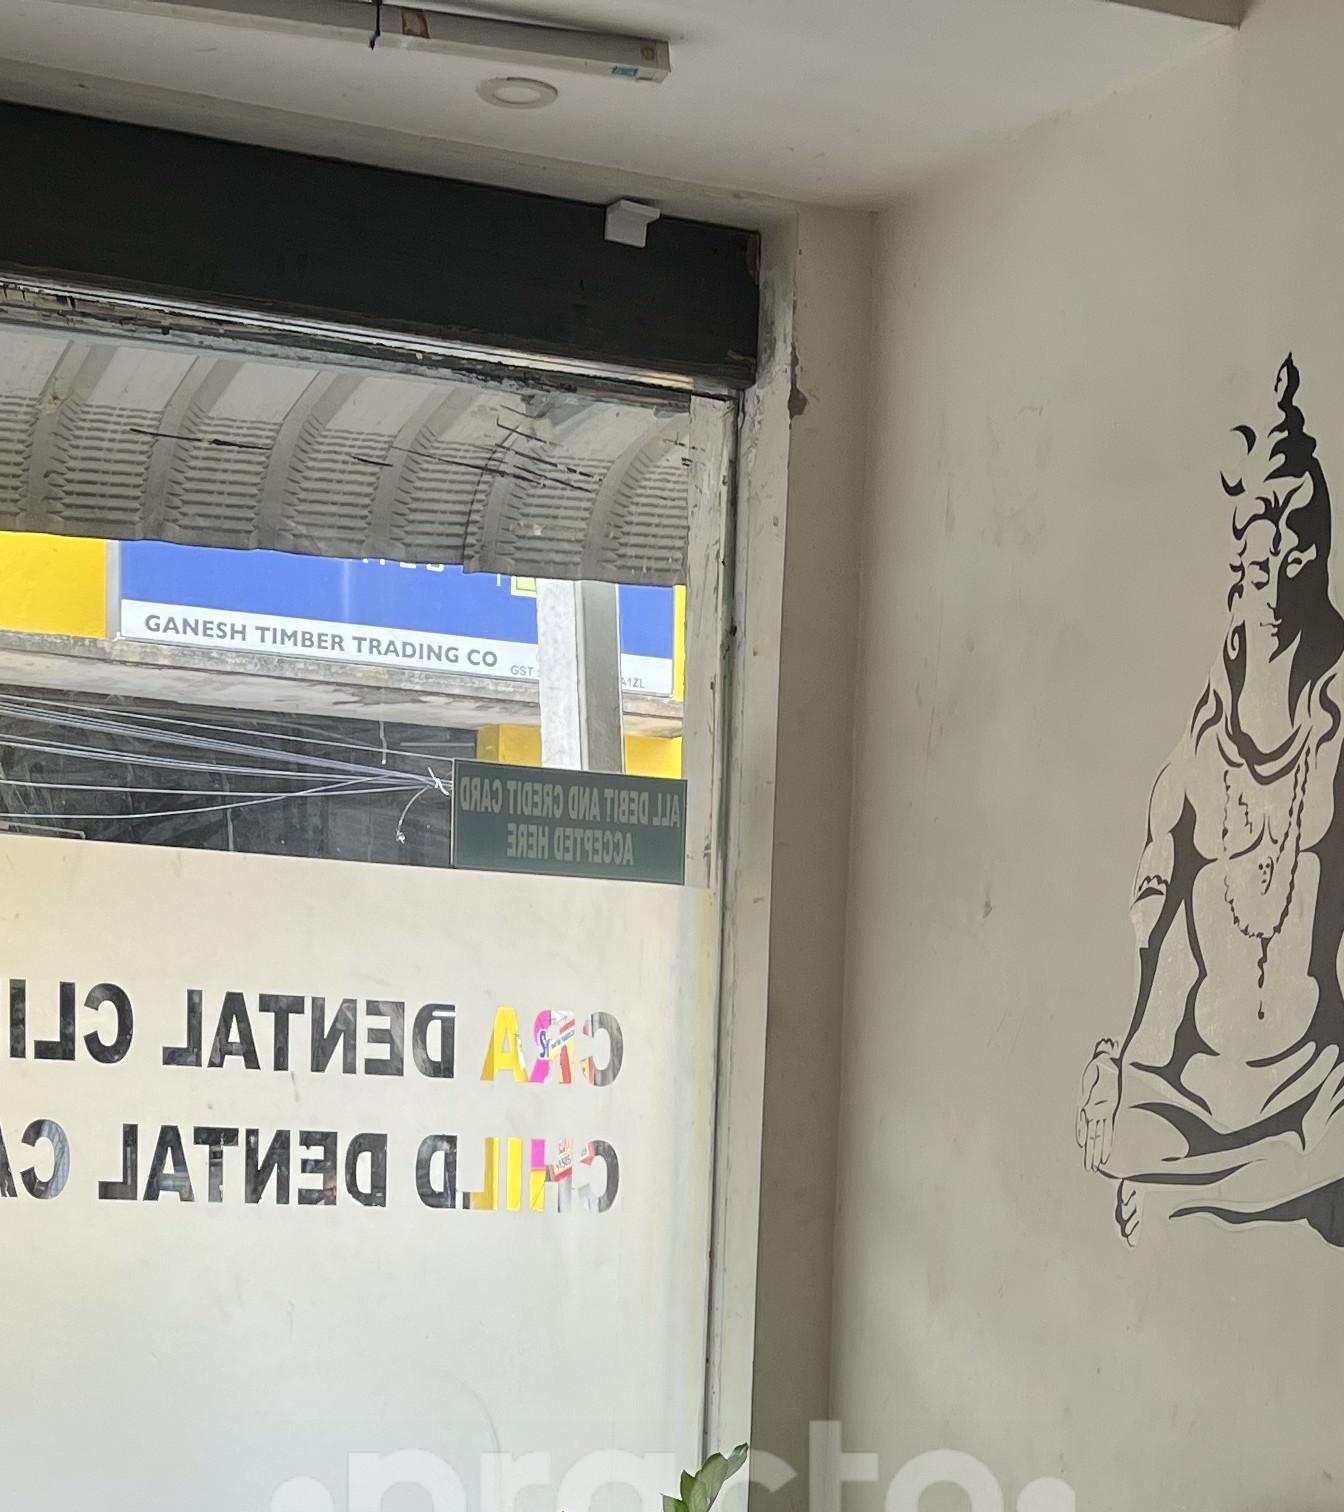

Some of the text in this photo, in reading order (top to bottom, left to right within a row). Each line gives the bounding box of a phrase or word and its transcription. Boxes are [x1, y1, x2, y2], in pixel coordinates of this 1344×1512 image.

[144, 614, 499, 668] GANESH TIMBER TRADING CO
[510, 664, 535, 676] GST
